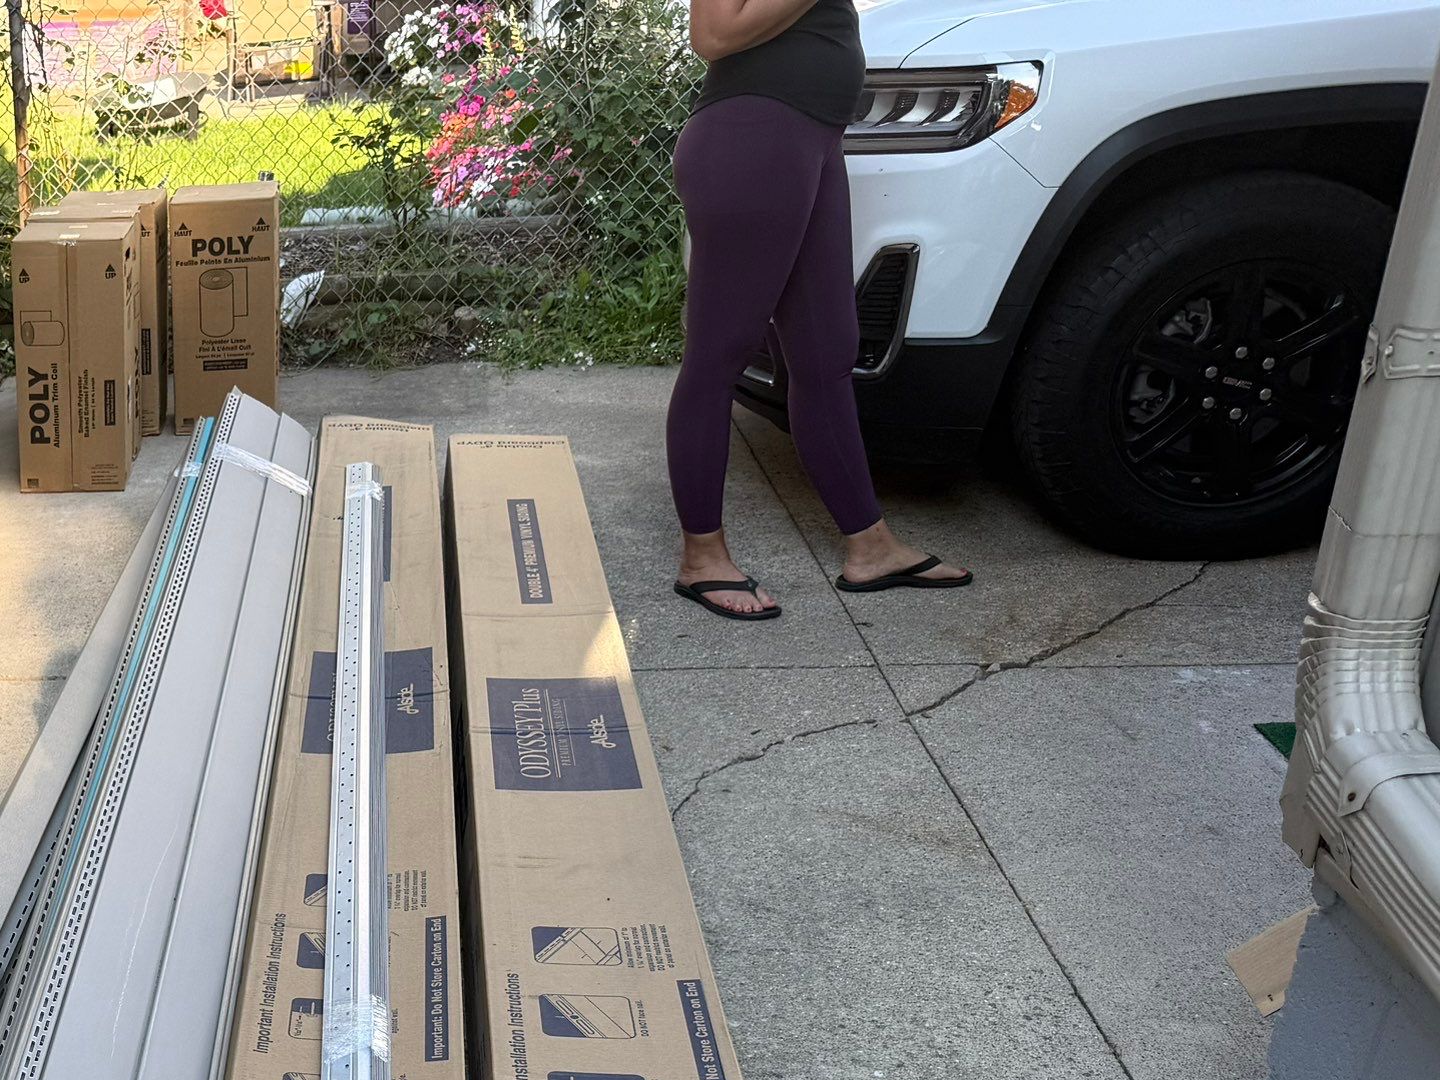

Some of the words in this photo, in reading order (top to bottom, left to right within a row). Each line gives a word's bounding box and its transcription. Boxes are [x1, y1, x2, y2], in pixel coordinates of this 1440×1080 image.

[191, 235, 254, 257] POLY
[234, 255, 270, 263] Aluminium
[50, 363, 58, 380] Coil
[28, 366, 51, 444] POLY
[52, 404, 60, 448] Aluminum
[515, 503, 530, 522] SIDING
[519, 521, 532, 539] VINYL
[521, 540, 538, 566] PREMIUM
[526, 572, 543, 598] DOUBLE
[512, 688, 542, 712] Plus
[587, 714, 616, 748] Alside
[514, 712, 551, 778] ODYSSEY
[431, 918, 442, 931] End
[266, 913, 286, 959] Instructions
[433, 932, 442, 941] on
[431, 942, 442, 966] Carton
[655, 956, 664, 964] NOT
[259, 961, 280, 1007] Installation
[431, 967, 443, 988] Store
[431, 988, 442, 1002] Not
[505, 973, 524, 1027] Instructions
[683, 982, 698, 997] End
[431, 1003, 443, 1015] Do
[690, 998, 701, 1009] on
[253, 1009, 274, 1053] Important
[638, 1020, 647, 1029] NOT
[693, 1010, 708, 1038] Carton
[431, 1016, 445, 1059] Important:
[700, 1039, 715, 1062] Store
[704, 1064, 719, 1080] Not
